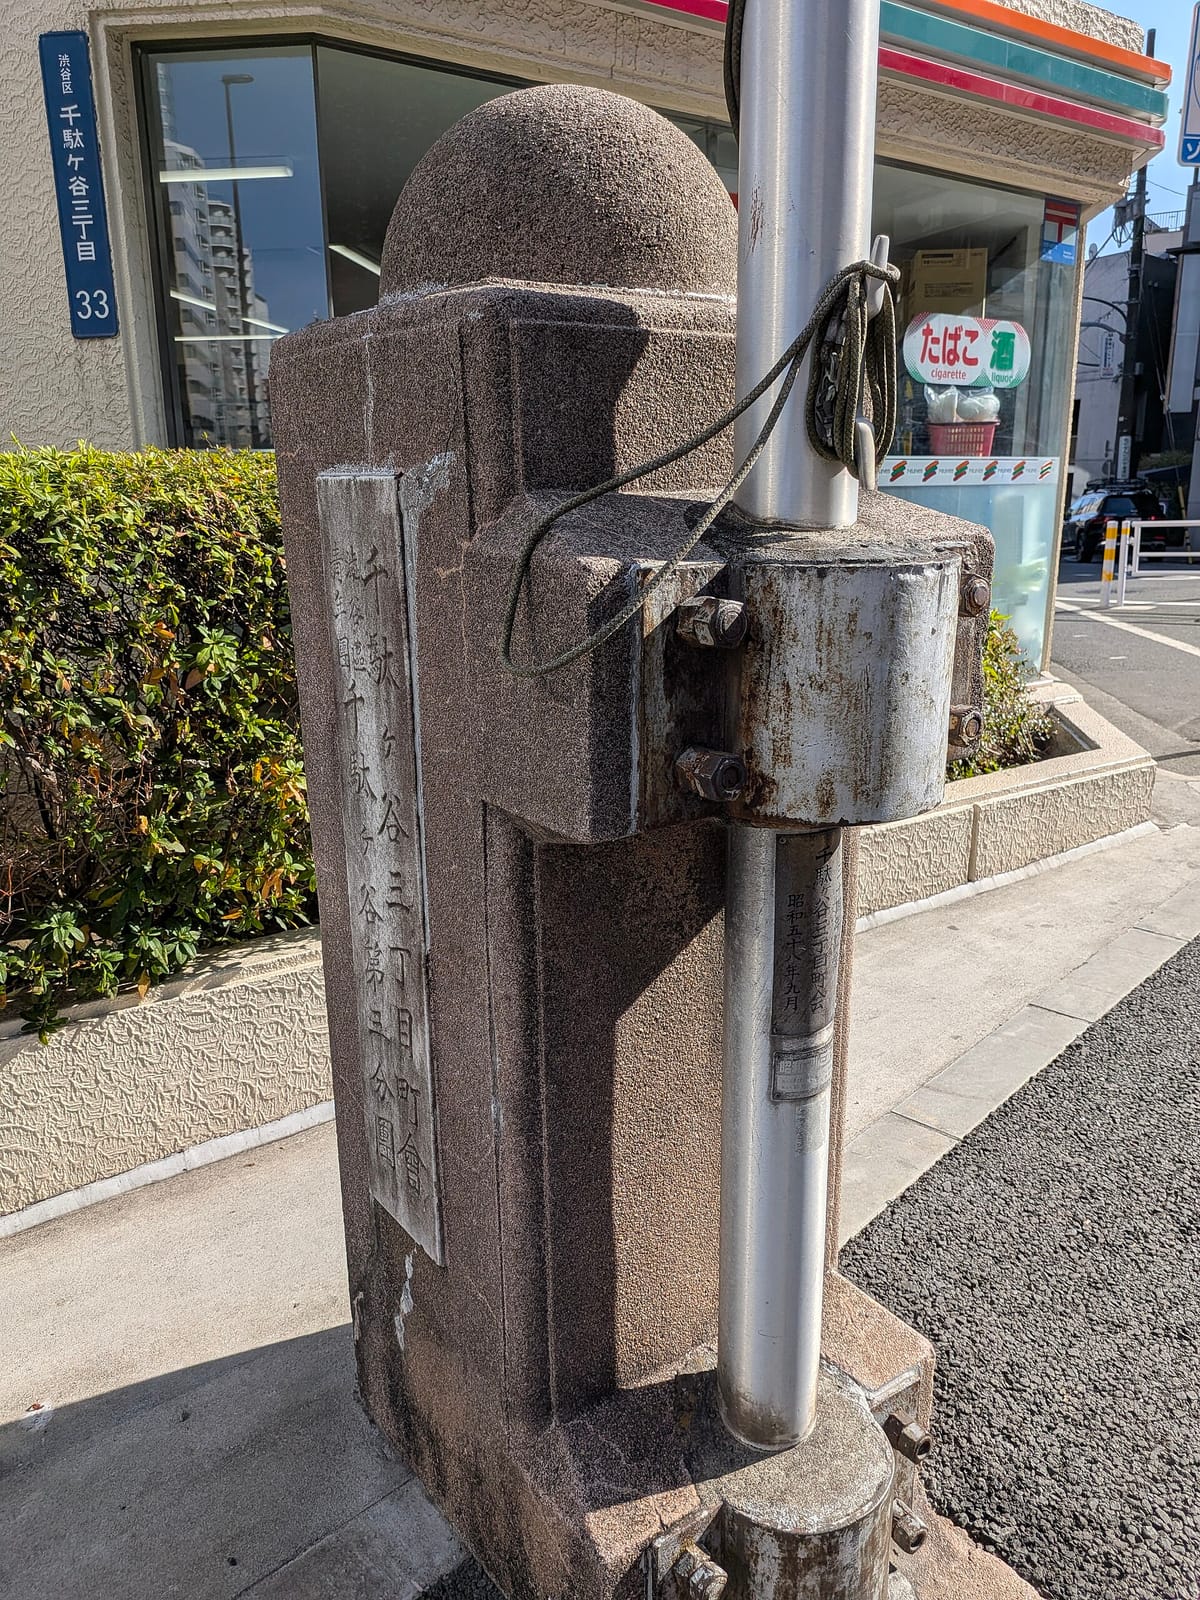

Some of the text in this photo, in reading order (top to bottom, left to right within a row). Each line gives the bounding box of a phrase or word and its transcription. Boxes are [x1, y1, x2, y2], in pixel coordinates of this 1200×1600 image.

[57, 53, 73, 94] 渋谷区
[76, 289, 110, 320] 33
[920, 323, 979, 367] たばこ
[990, 330, 1016, 370] 酒
[931, 368, 967, 381] cigarette
[991, 372, 1014, 385] liquor
[783, 893, 805, 1012] 昭和五十八年九月
